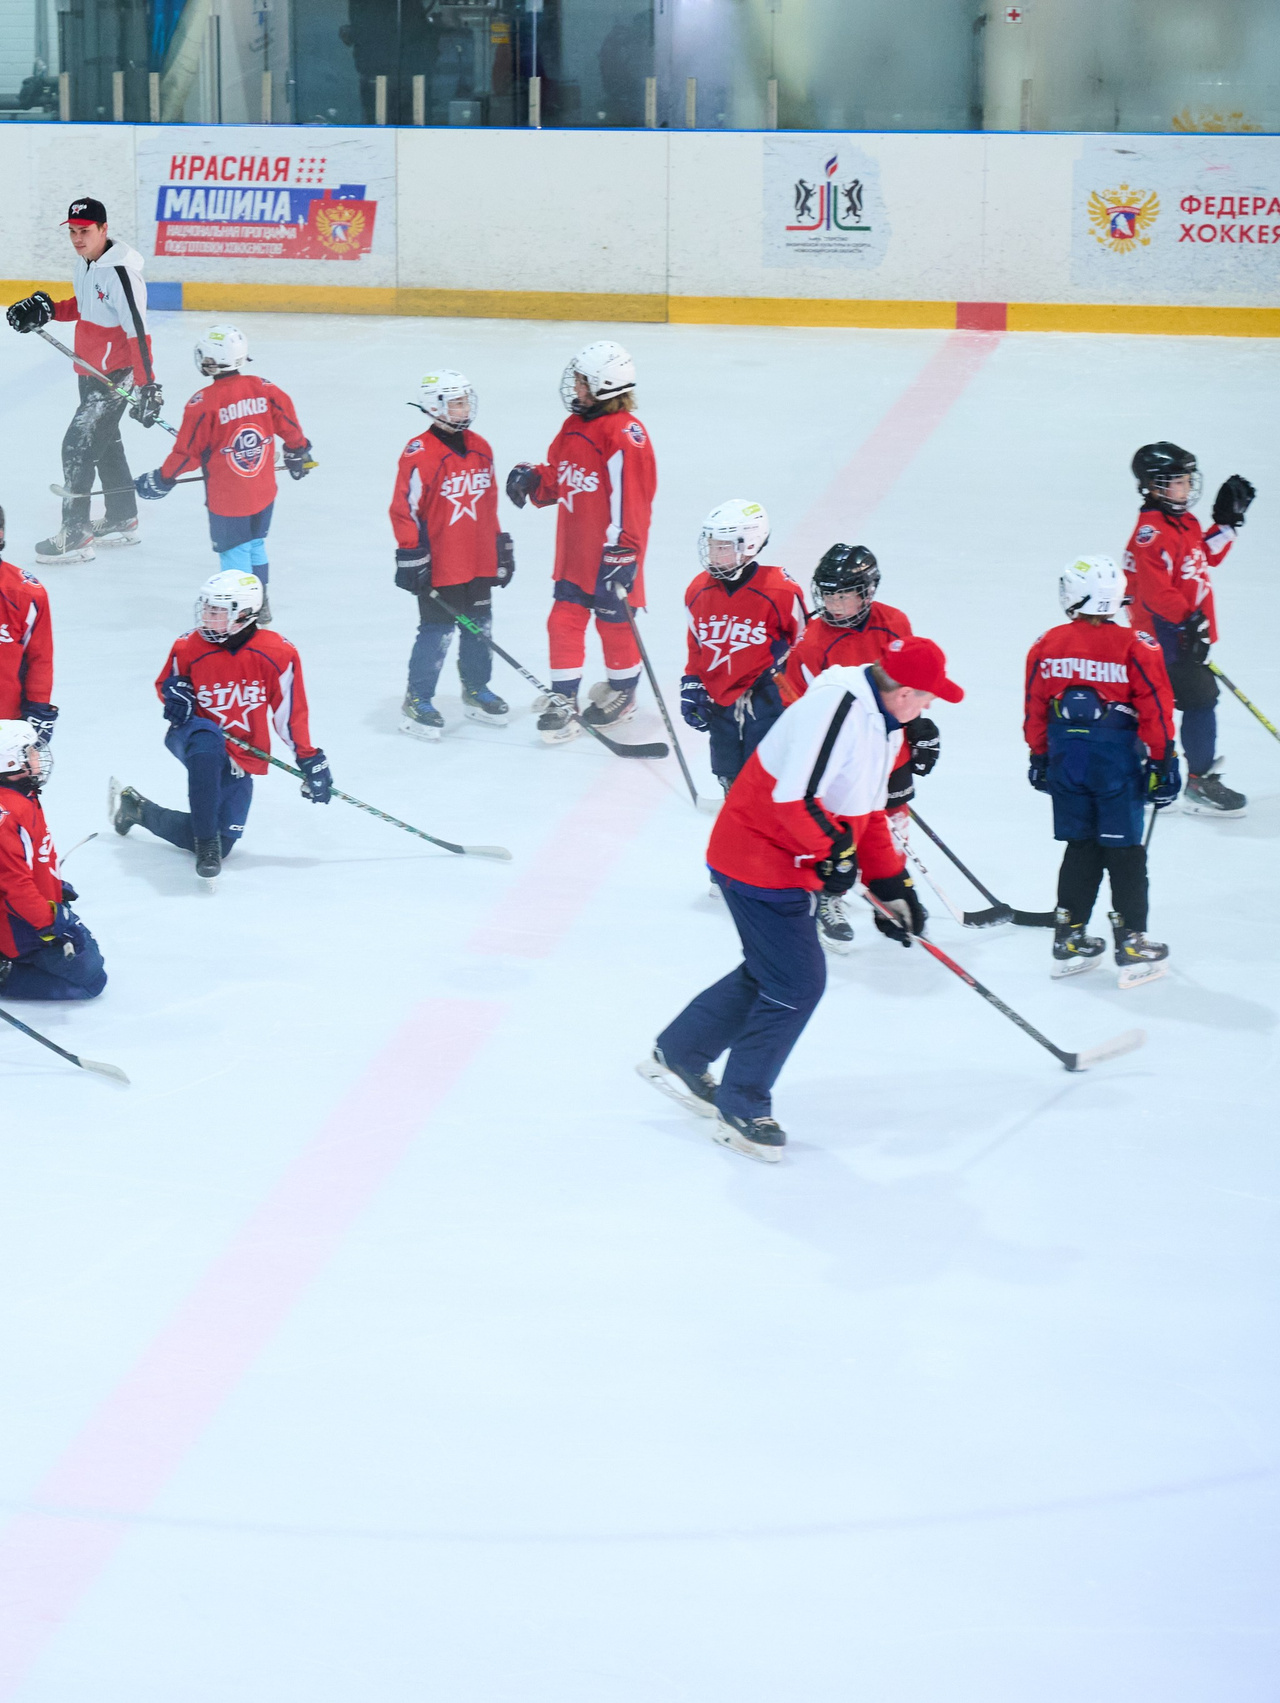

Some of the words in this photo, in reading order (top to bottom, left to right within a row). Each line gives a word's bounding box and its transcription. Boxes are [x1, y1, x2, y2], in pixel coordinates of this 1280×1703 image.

[170, 155, 291, 182] КРАСНАЯ
[163, 188, 292, 222] МАШИНА
[1180, 195, 1280, 219] ФЕДЕРА
[239, 433, 257, 448] 10
[235, 446, 262, 460] STEPS
[27, 716, 54, 729] CC
